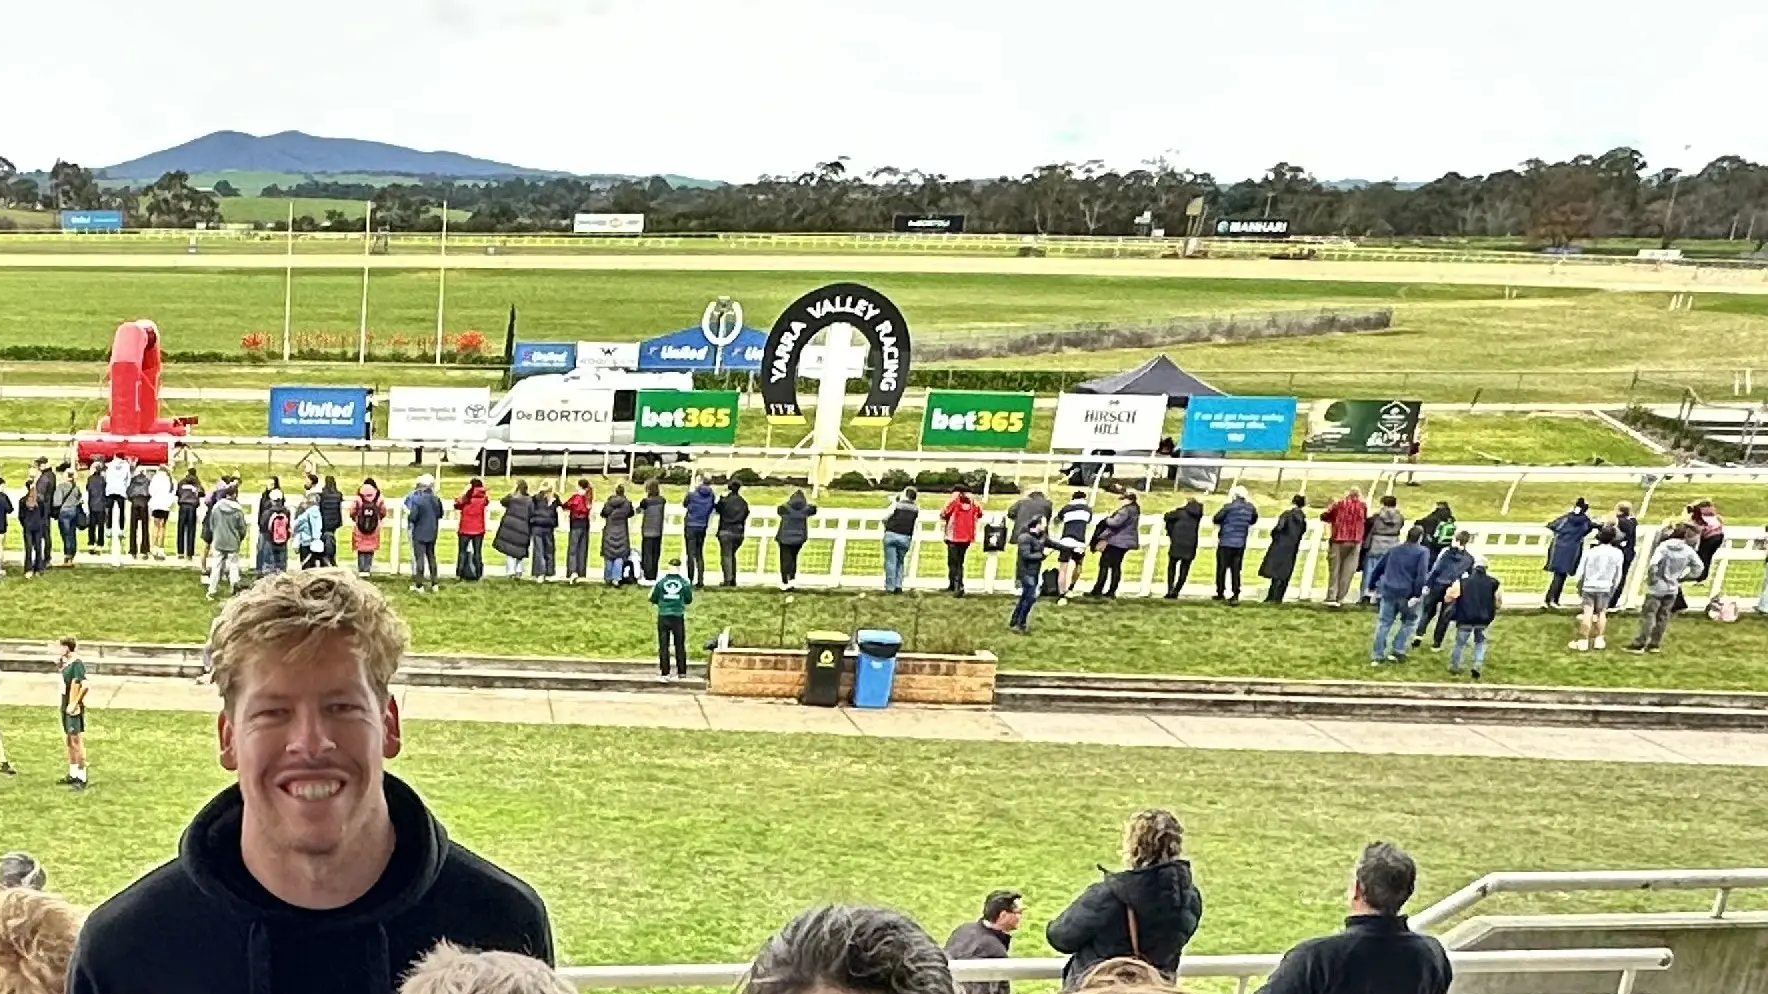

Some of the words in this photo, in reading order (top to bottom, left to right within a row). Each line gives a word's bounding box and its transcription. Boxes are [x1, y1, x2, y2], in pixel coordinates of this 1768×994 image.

[770, 321, 807, 384] YARRA
[806, 296, 881, 321] VALLEY
[875, 320, 900, 392] RACING
[298, 400, 355, 418] United
[535, 410, 609, 423] BORTOLI
[641, 406, 731, 428] bet365
[1084, 409, 1138, 424] HIRSCH
[931, 408, 1025, 433] bet365
